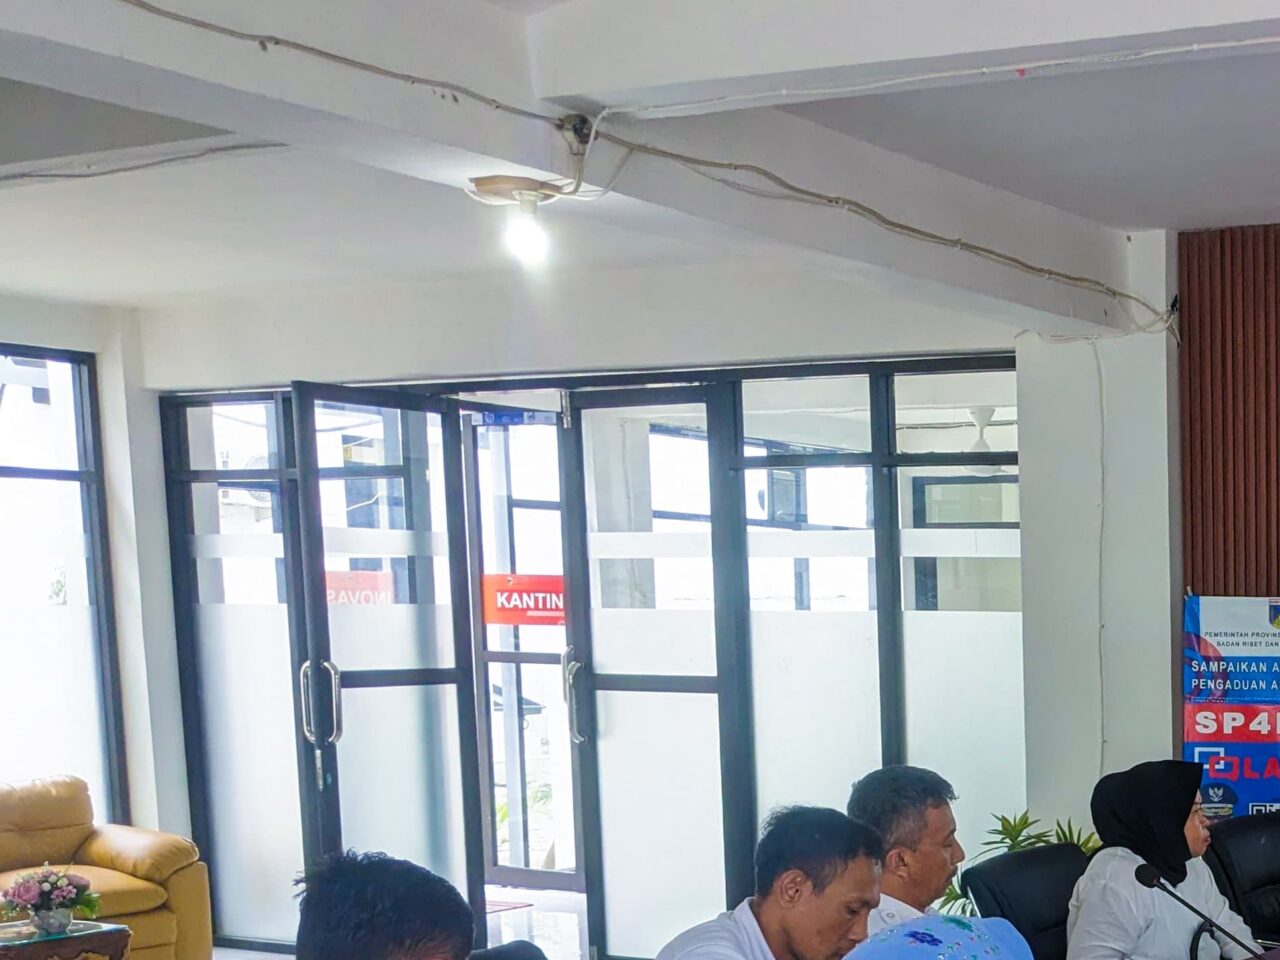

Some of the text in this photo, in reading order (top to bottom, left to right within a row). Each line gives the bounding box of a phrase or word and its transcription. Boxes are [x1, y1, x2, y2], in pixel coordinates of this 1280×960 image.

[496, 592, 564, 609] KANTIN
[1204, 631, 1249, 639] PEMERINTAH
[1191, 660, 1267, 673] SAMPAIKAN
[1191, 678, 1267, 690] PENGADUAN
